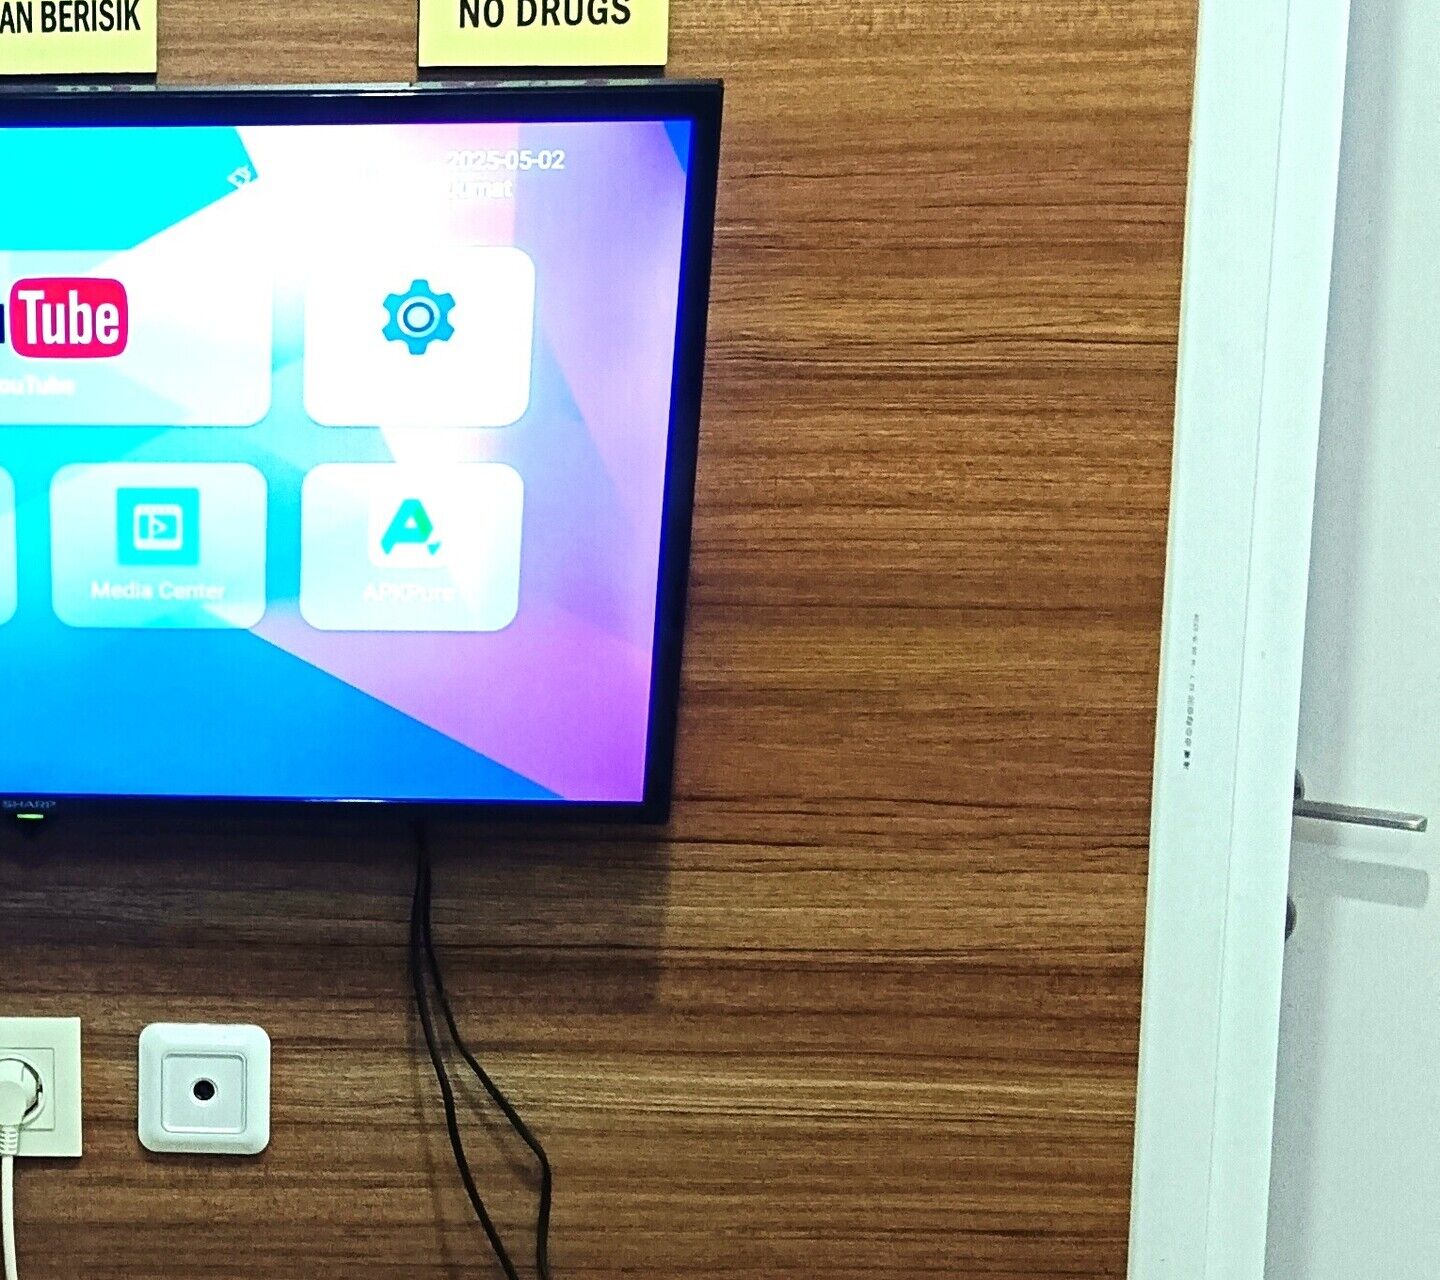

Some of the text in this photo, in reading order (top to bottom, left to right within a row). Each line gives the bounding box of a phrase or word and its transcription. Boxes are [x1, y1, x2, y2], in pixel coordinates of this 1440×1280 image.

[446, 150, 565, 171] 2025-05-02
[90, 580, 226, 601] Media Center
[2, 800, 56, 808] SHARP
